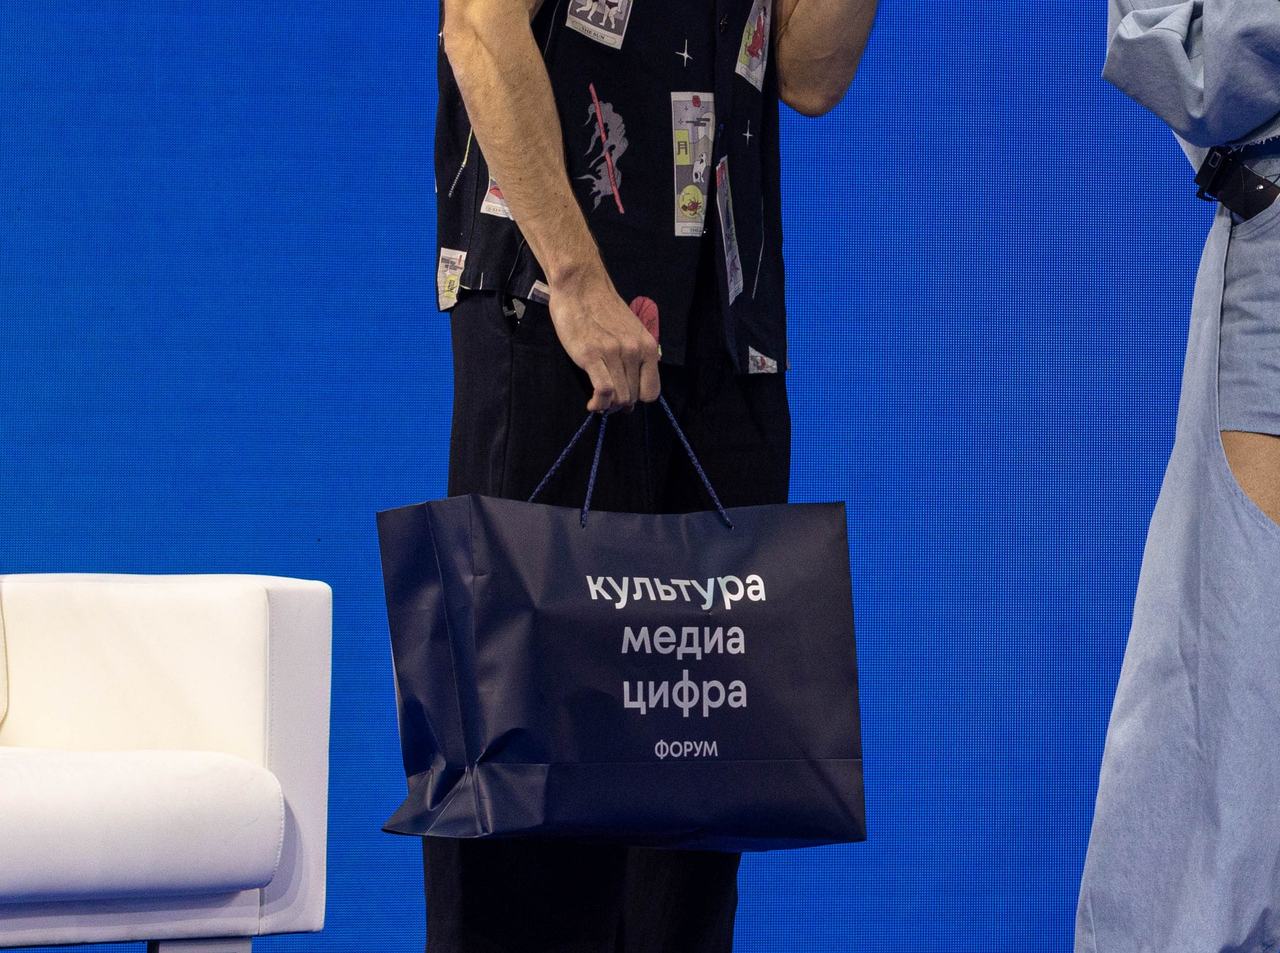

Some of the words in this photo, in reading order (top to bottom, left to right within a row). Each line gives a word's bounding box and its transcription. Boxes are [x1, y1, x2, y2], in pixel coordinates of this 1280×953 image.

[585, 573, 767, 610] культура
[621, 625, 746, 661] медиа
[623, 669, 747, 718] цифра
[654, 739, 719, 760] ФОРУМ
